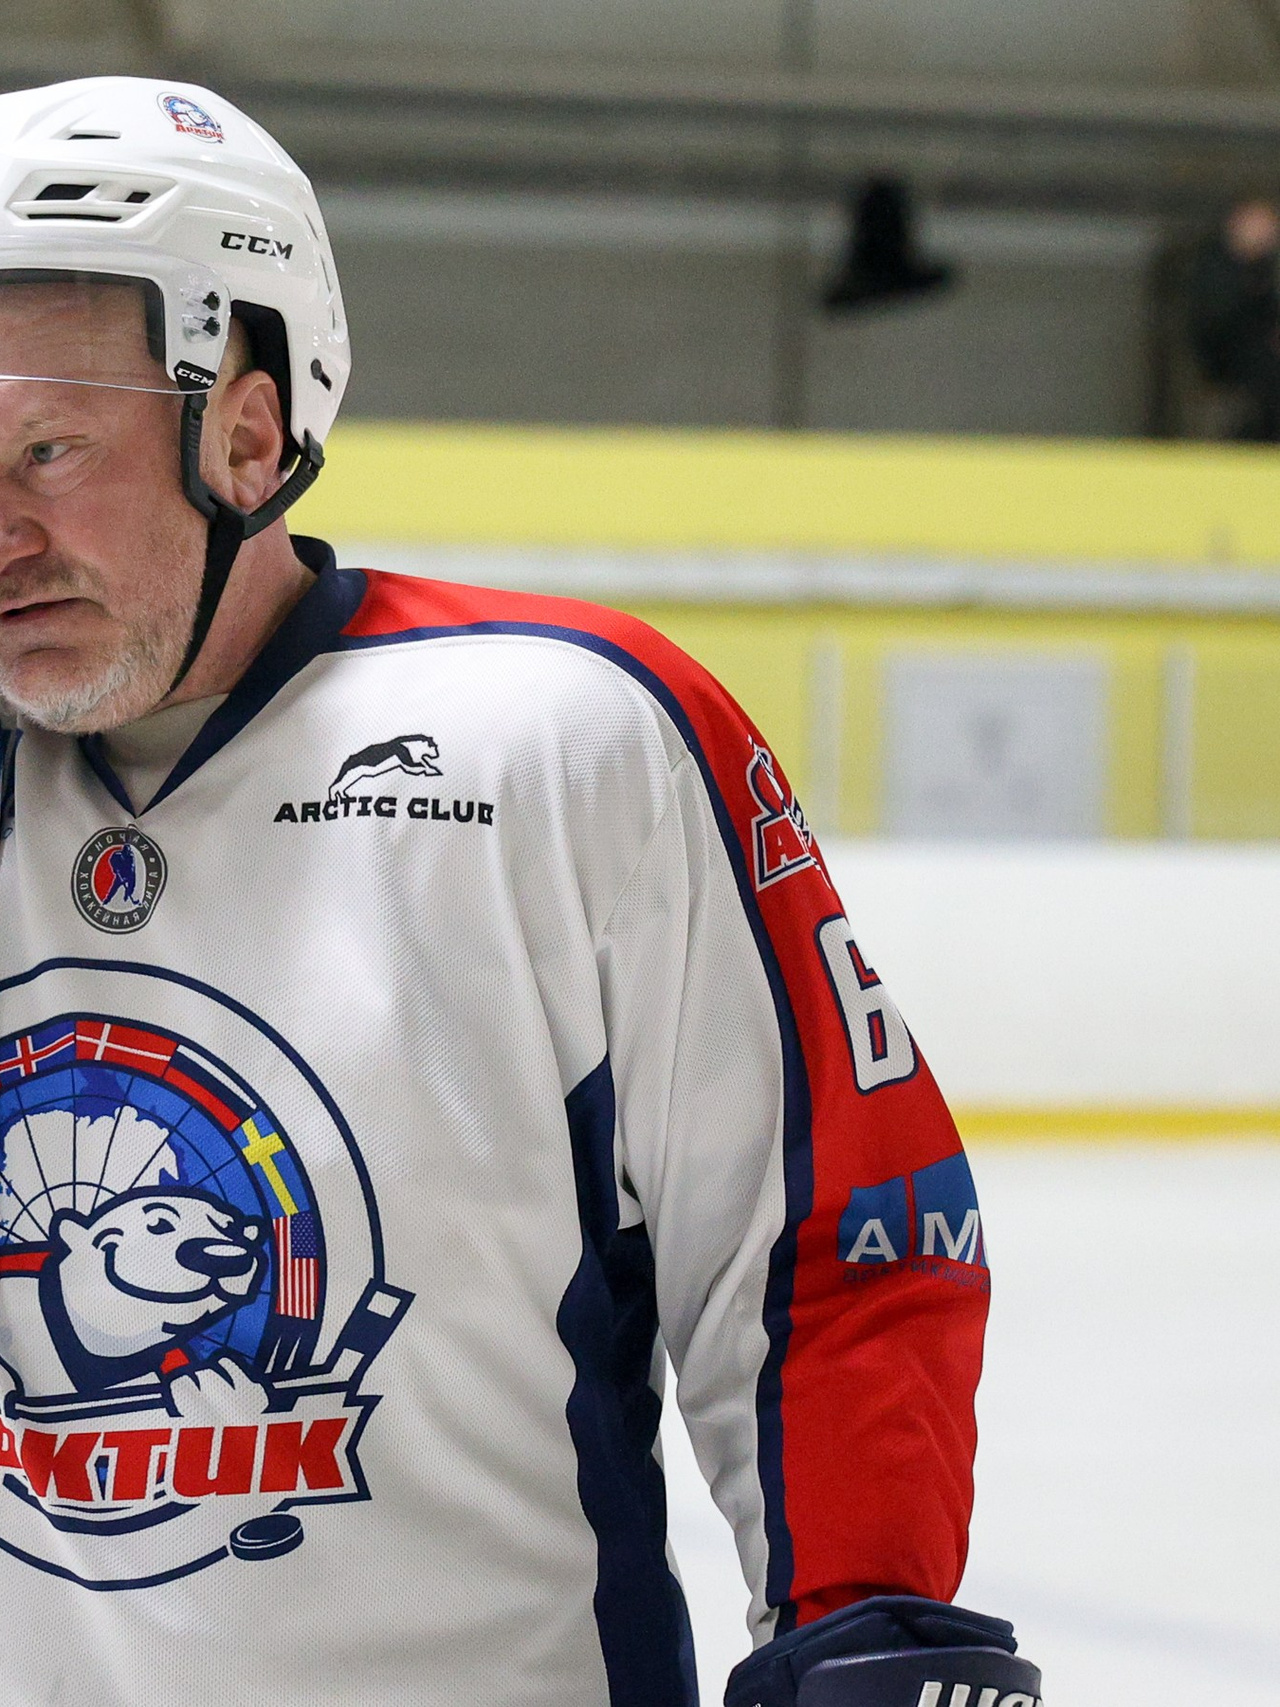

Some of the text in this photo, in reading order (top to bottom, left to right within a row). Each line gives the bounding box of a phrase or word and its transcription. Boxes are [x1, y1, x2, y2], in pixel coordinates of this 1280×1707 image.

[220, 231, 293, 260] CCM
[176, 367, 214, 386] CCM
[273, 796, 397, 823] ARCTIC
[80, 871, 140, 926] ХОККЕЙНАЯ
